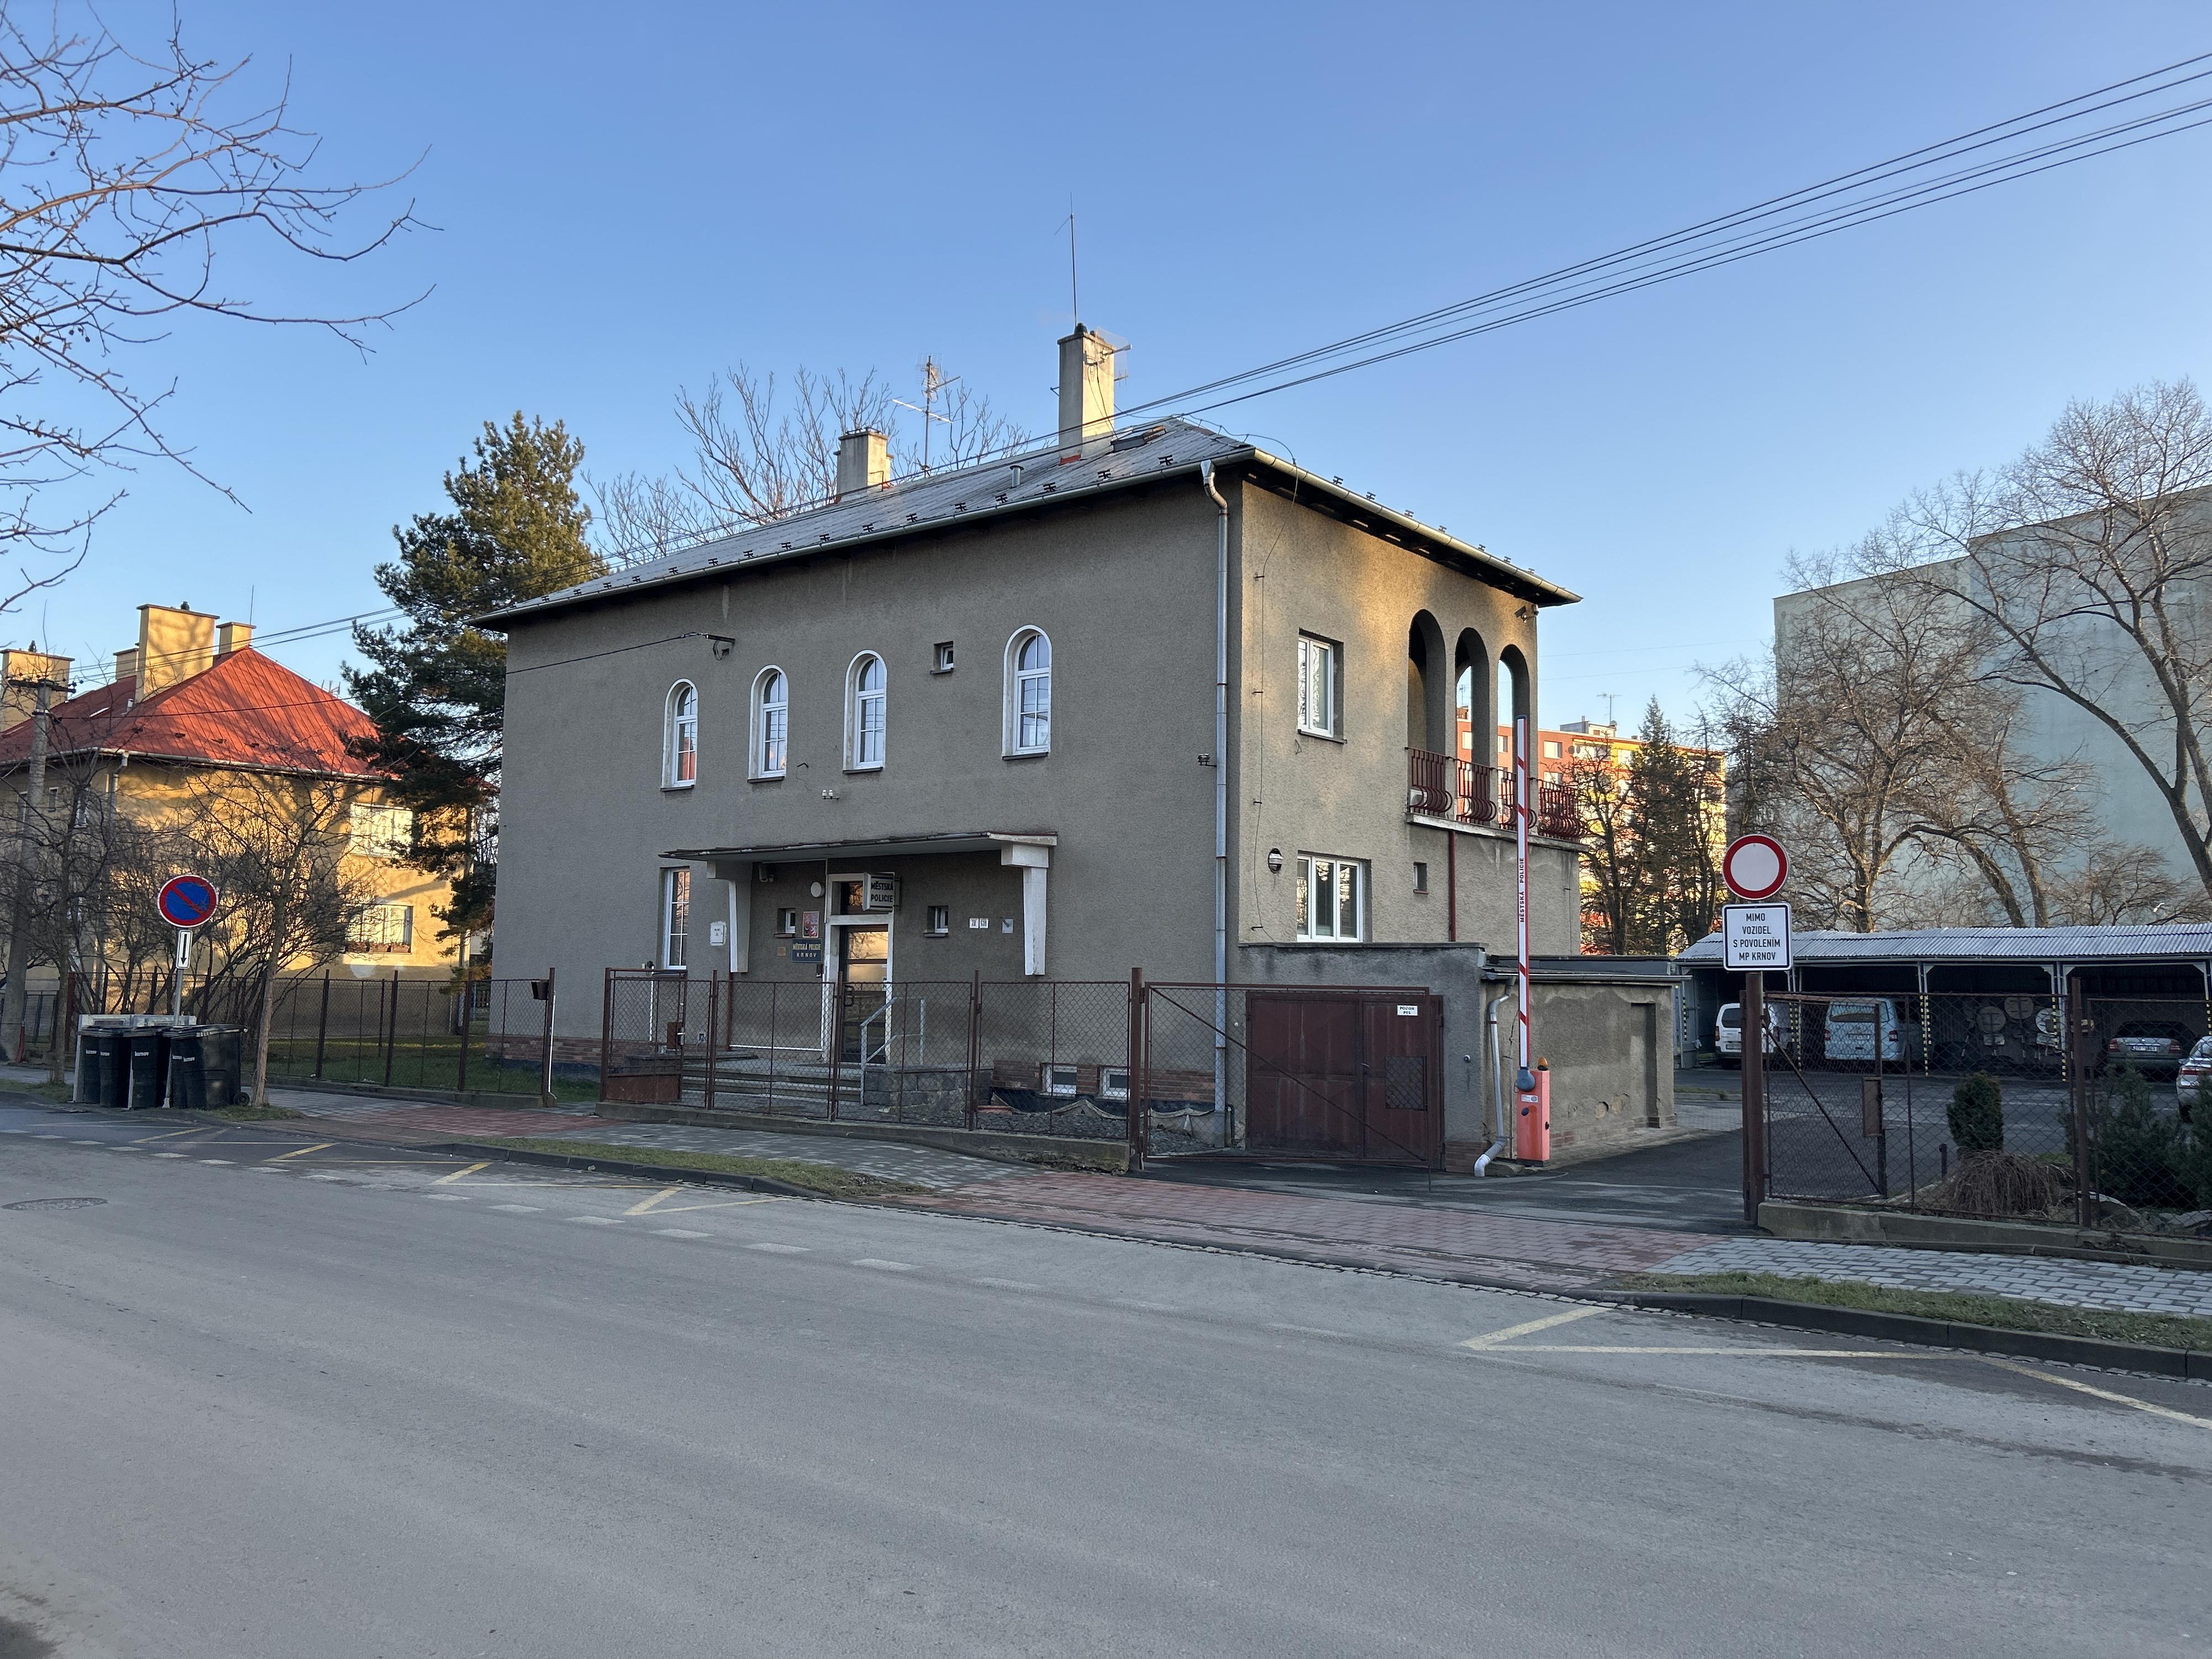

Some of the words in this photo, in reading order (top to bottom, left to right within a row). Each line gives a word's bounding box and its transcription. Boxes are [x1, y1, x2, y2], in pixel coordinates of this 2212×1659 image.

[871, 881, 894, 891] MĚSTSKÁ
[871, 894, 893, 902] POLICIE
[1746, 913, 1765, 921] MIMO
[1742, 926, 1771, 935] VOZIDEL
[1733, 939, 1738, 948] S
[1740, 936, 1781, 947] POVOLENÍM
[1739, 952, 1750, 961] MP
[1752, 952, 1776, 961] KRNOV
